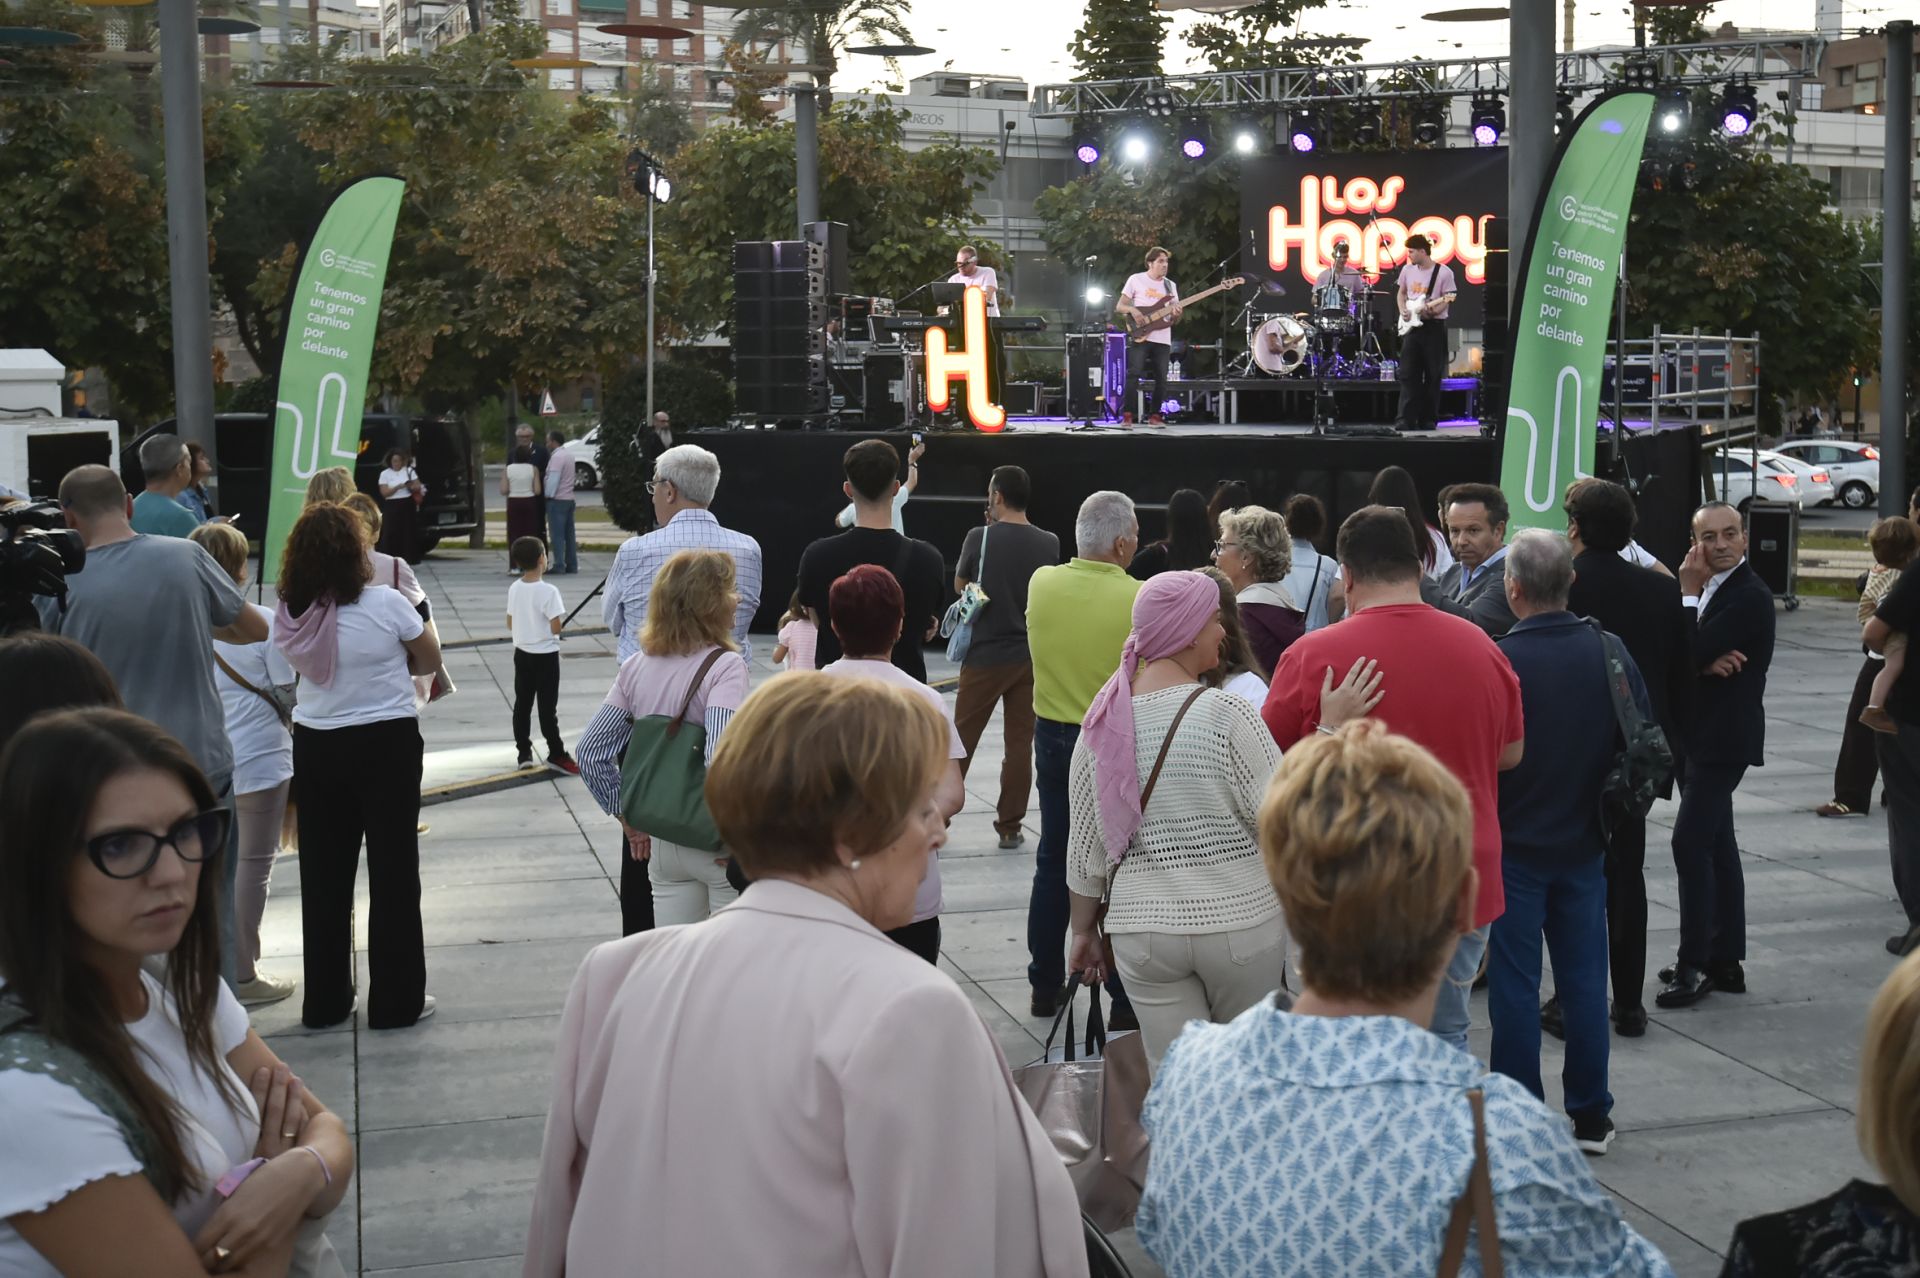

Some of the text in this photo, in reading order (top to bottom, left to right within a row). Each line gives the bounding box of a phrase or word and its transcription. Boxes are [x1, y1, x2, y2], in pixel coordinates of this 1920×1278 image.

[1552, 240, 1606, 272] Tenemos
[1546, 263, 1593, 288] un gran
[314, 280, 368, 305] Tenemos
[1543, 283, 1588, 306] camino
[310, 297, 355, 317] un gran
[1539, 303, 1562, 319] por
[307, 312, 351, 331] camino
[303, 326, 326, 339] por
[1536, 321, 1584, 346] delante
[301, 339, 349, 359] delante
